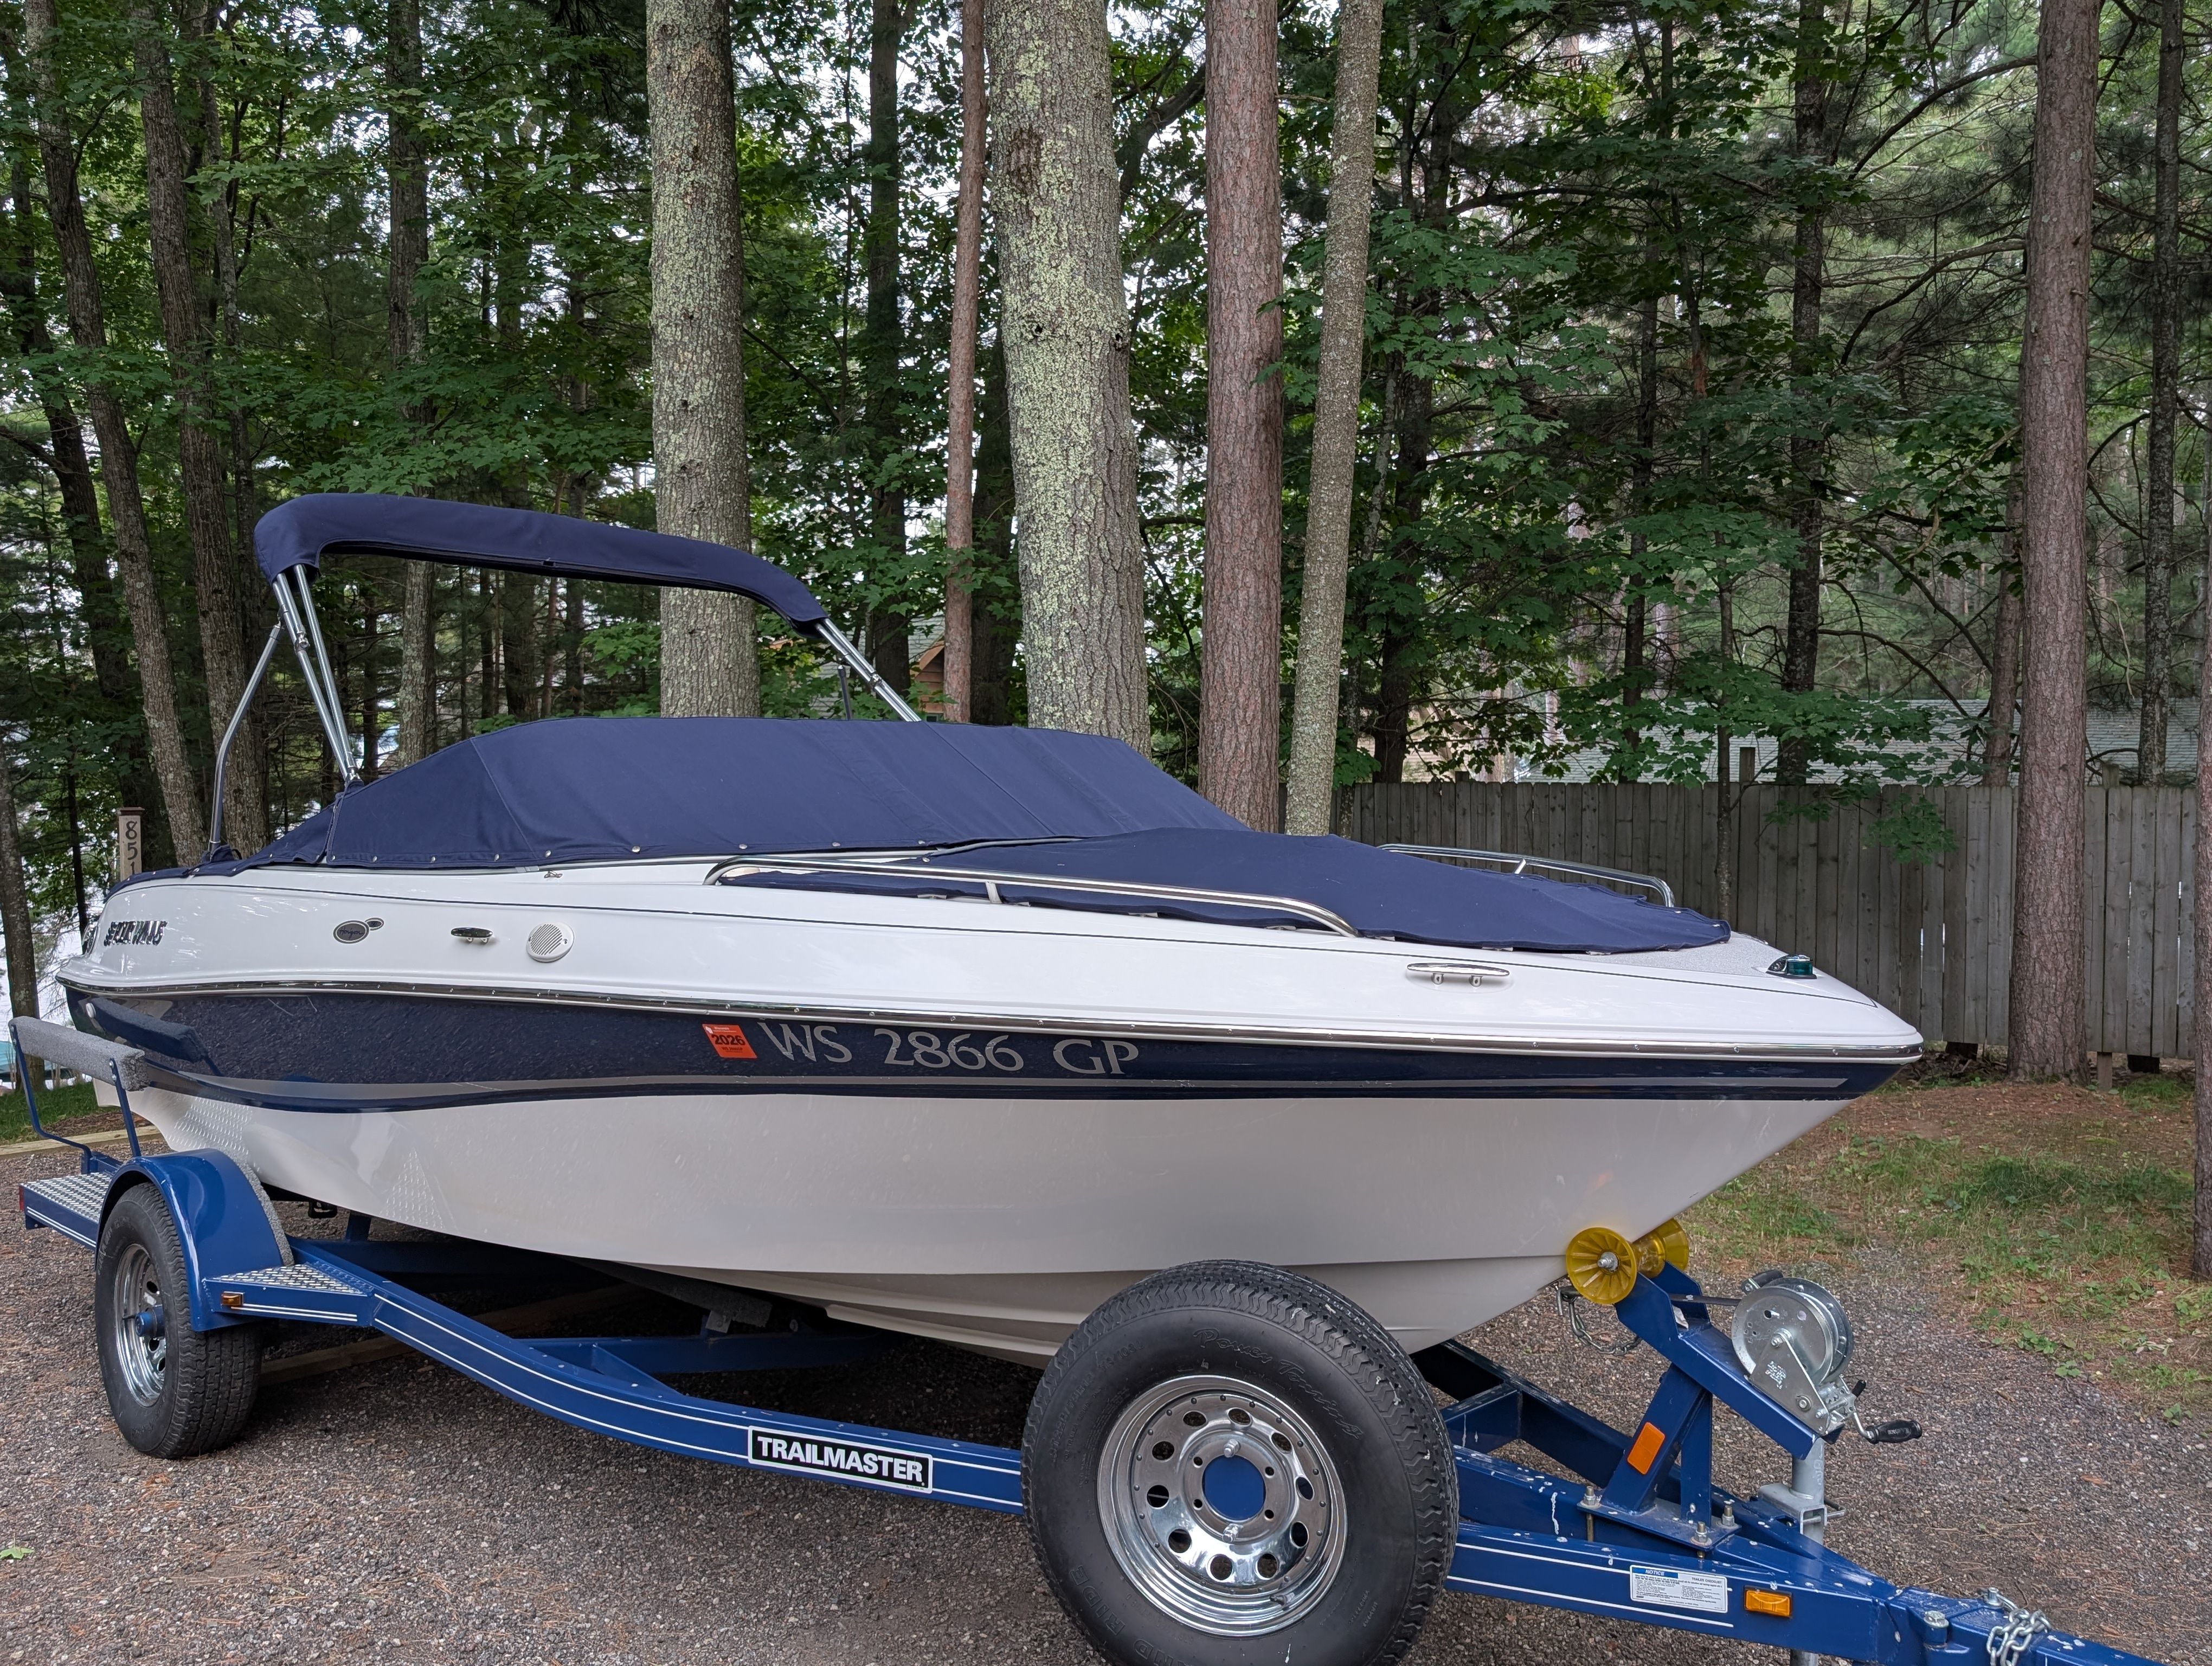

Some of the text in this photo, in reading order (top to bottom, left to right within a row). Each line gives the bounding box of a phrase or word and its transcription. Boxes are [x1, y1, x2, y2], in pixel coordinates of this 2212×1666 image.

[125, 821, 138, 875] 851
[711, 1034, 745, 1046] 2026
[757, 1022, 1139, 1074] WS 2866 GP
[757, 1436, 923, 1482] TRAILMASTER
[1069, 1566, 1126, 1636] RIDE
